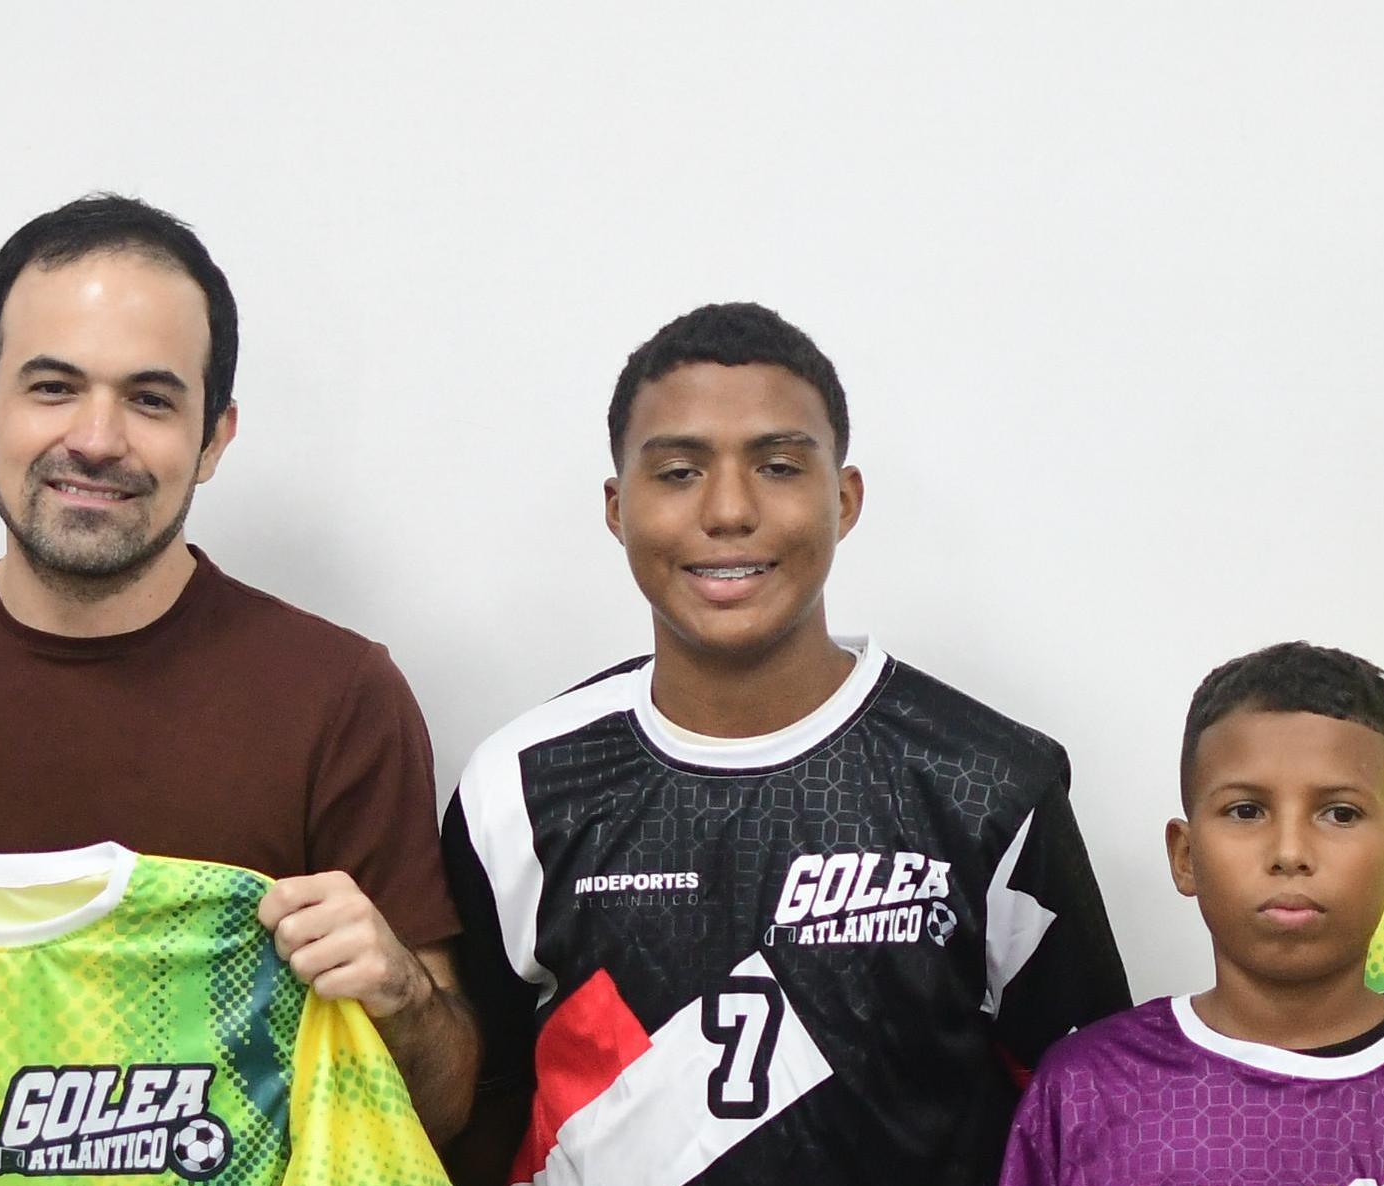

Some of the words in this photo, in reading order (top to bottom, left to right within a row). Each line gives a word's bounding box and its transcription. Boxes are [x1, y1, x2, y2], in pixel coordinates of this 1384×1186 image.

[575, 872, 699, 894] INDEPORTES
[774, 852, 951, 925] GOLEA
[798, 905, 923, 945] ATLÁNTICO
[717, 992, 771, 1103] 7
[2, 1069, 212, 1147] GOLEA
[27, 1134, 169, 1171] ATLÁNTICO
